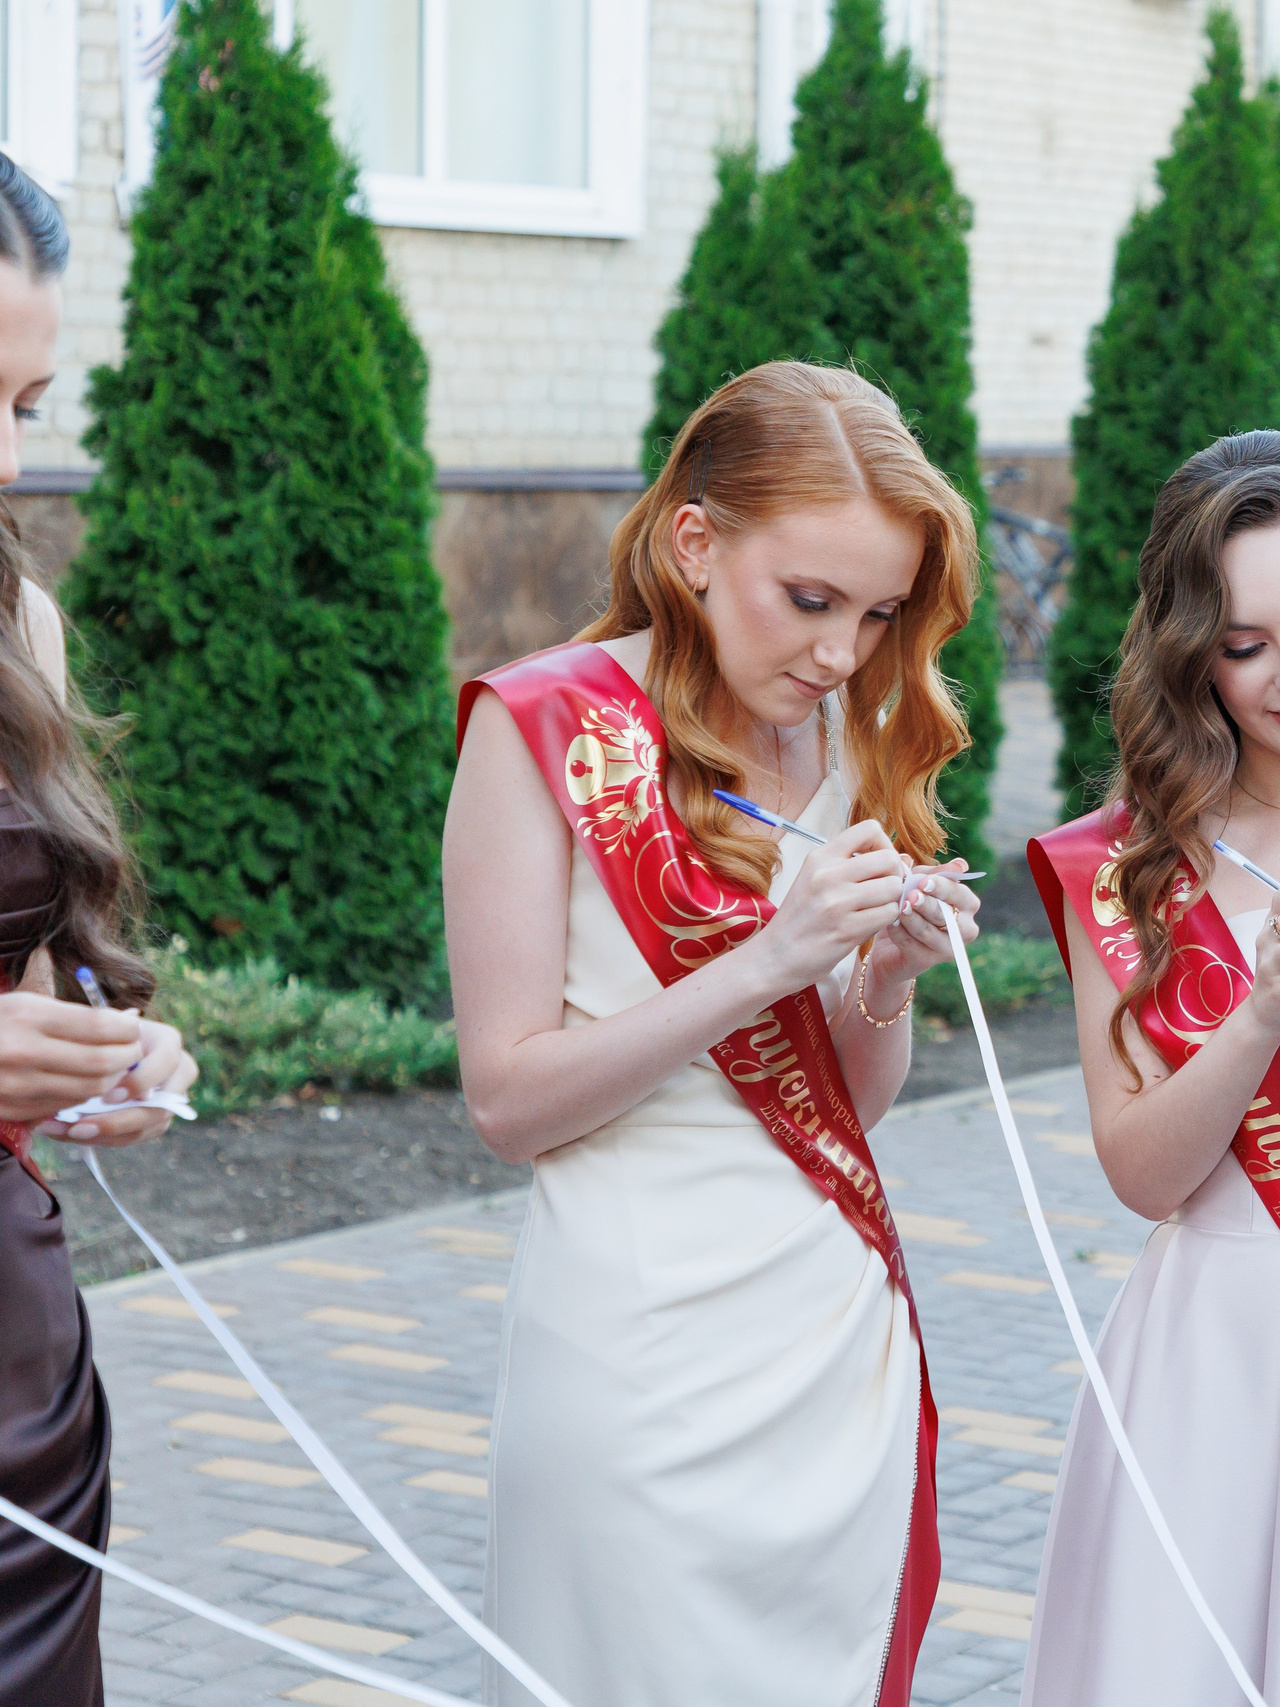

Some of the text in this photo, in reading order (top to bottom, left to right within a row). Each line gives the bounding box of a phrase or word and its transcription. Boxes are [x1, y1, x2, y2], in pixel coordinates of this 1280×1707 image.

[816, 1046, 863, 1140] Виктория
[759, 1100, 800, 1146] Школа
[810, 1156, 830, 1175] 35
